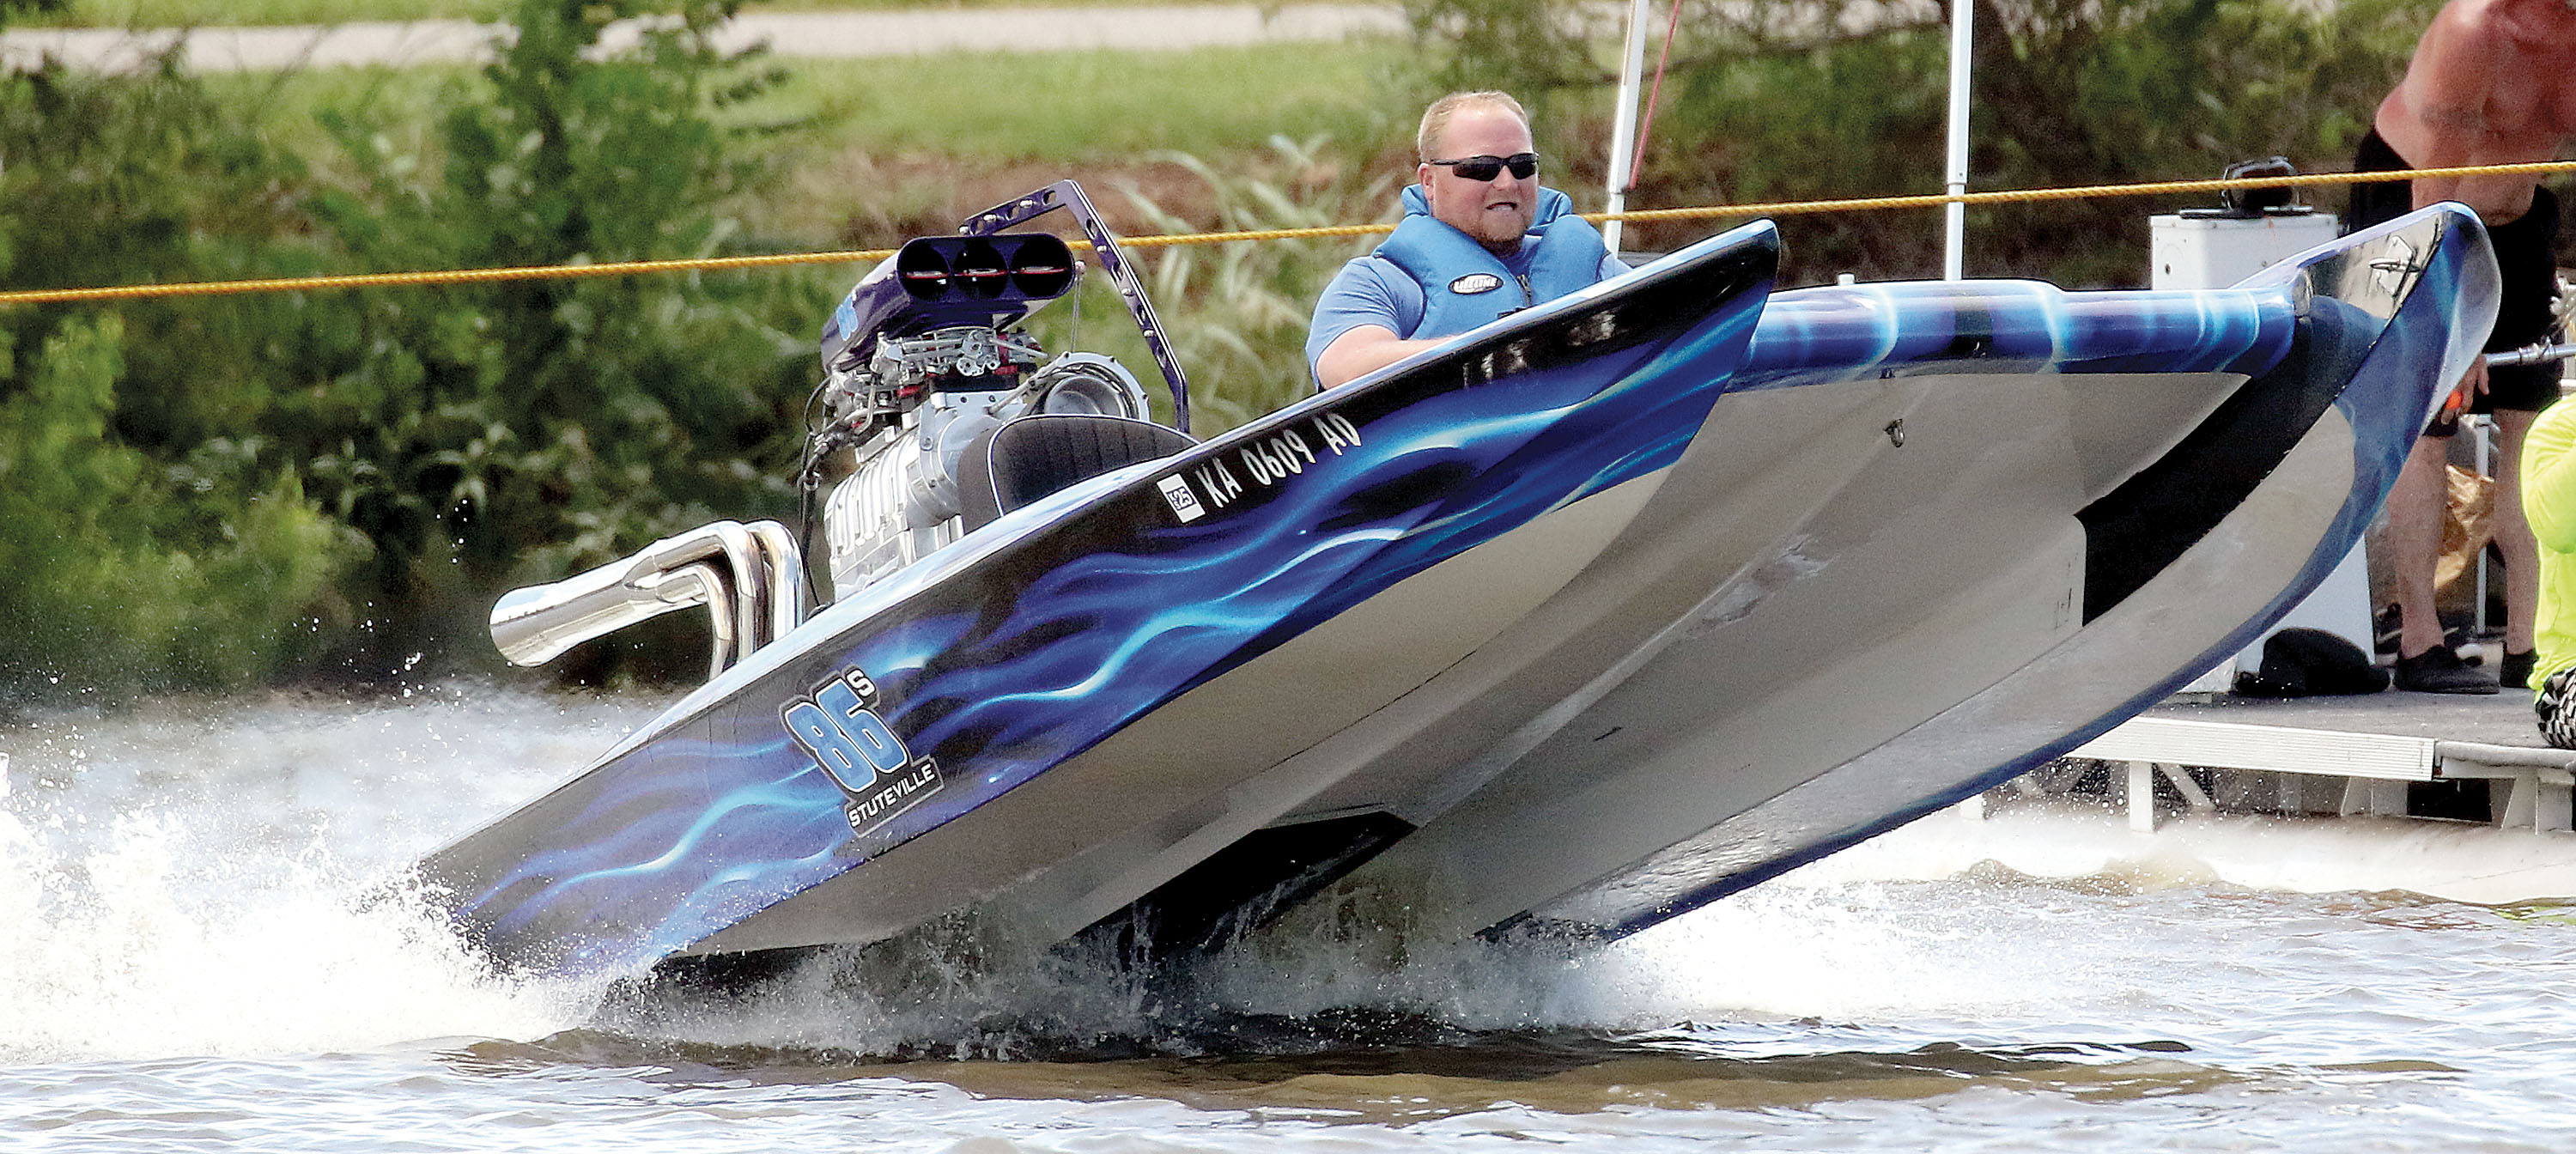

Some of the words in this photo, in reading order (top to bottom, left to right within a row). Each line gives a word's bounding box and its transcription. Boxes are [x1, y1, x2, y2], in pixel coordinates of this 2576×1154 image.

[1173, 488, 1194, 507] 25
[1195, 458, 1242, 507] KA
[1241, 429, 1315, 486] 0609
[785, 677, 908, 793] 86
[847, 669, 876, 697] S
[848, 763, 936, 828] STUTEVILLE
